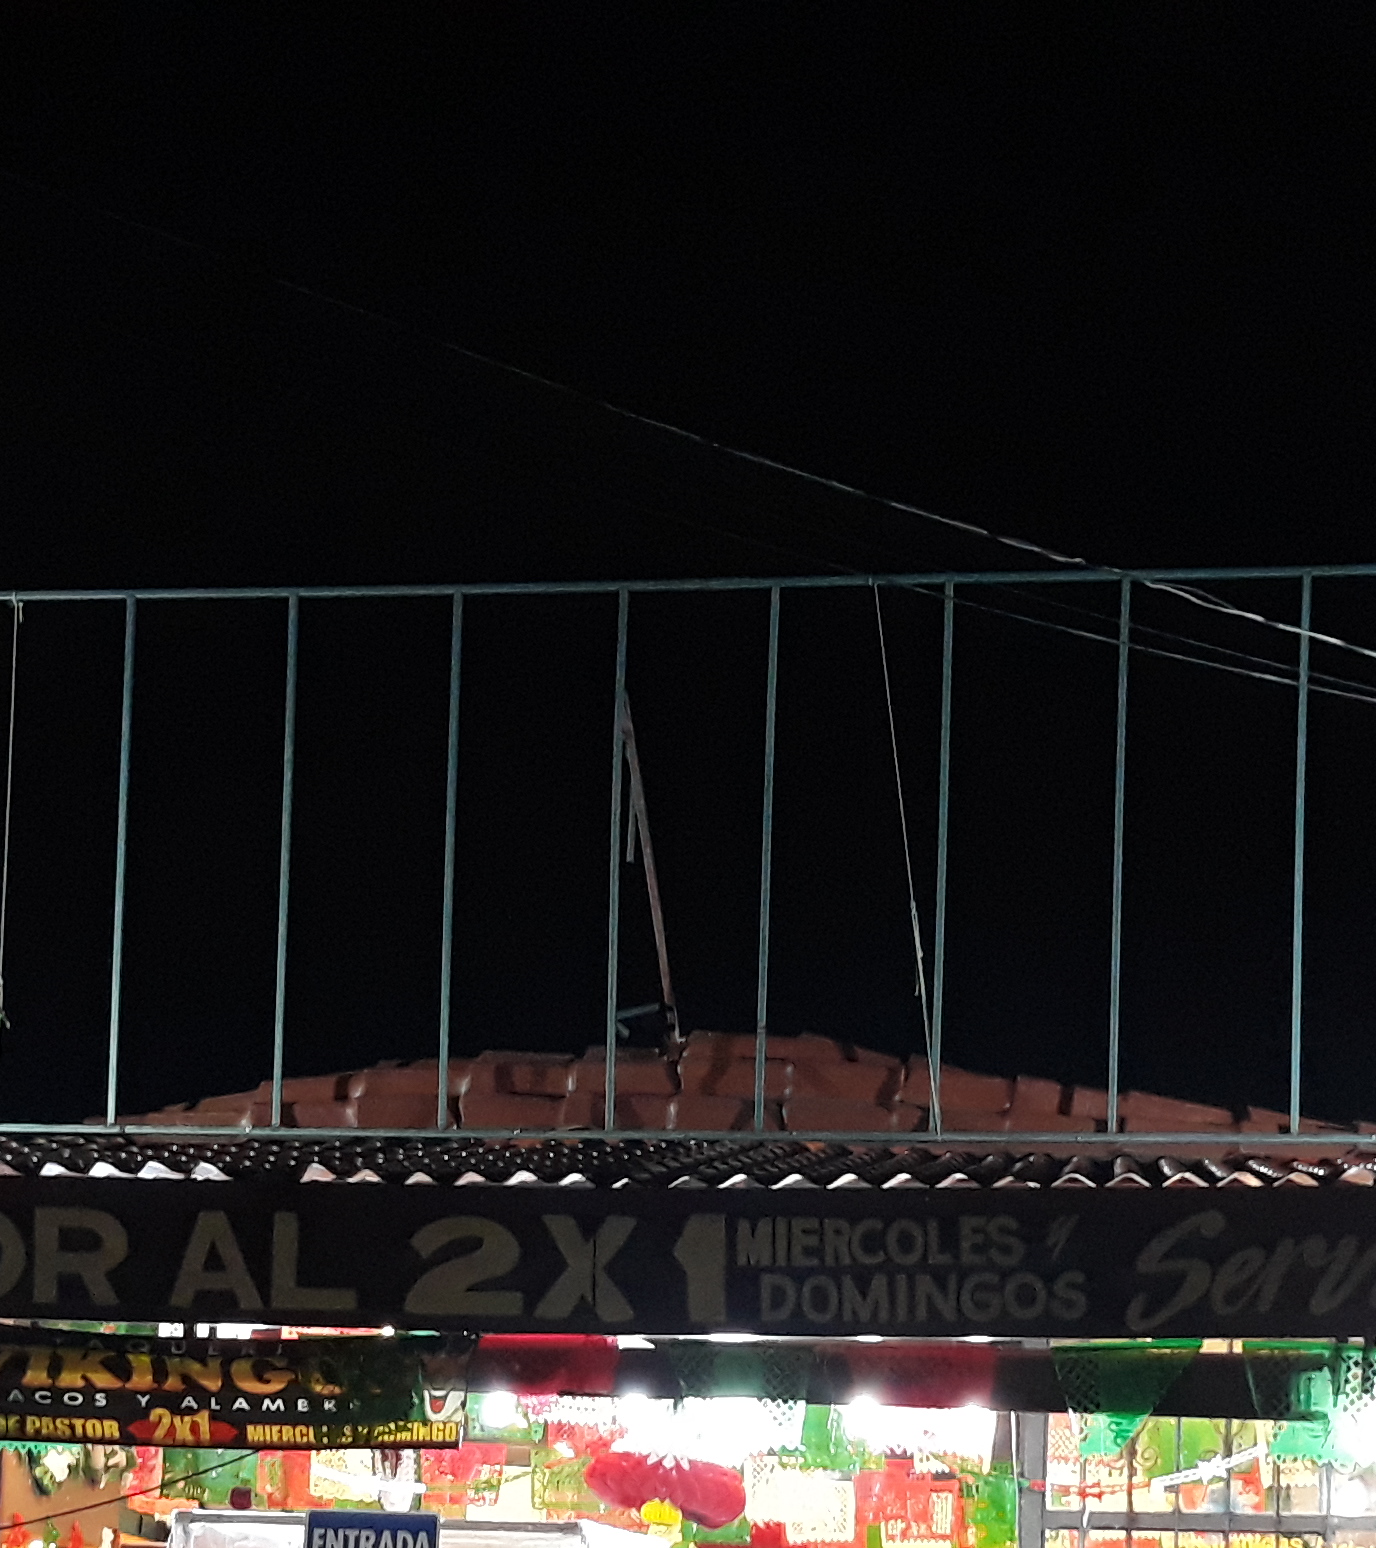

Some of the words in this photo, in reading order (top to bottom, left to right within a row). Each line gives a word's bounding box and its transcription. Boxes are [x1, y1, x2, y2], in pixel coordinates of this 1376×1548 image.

[168, 1209, 356, 1311] AL
[734, 1216, 1024, 1268] MIERCOLES
[760, 1270, 1088, 1322] DOMINGOS
[137, 1394, 151, 1407] Y
[26, 1416, 120, 1440] PASTOR
